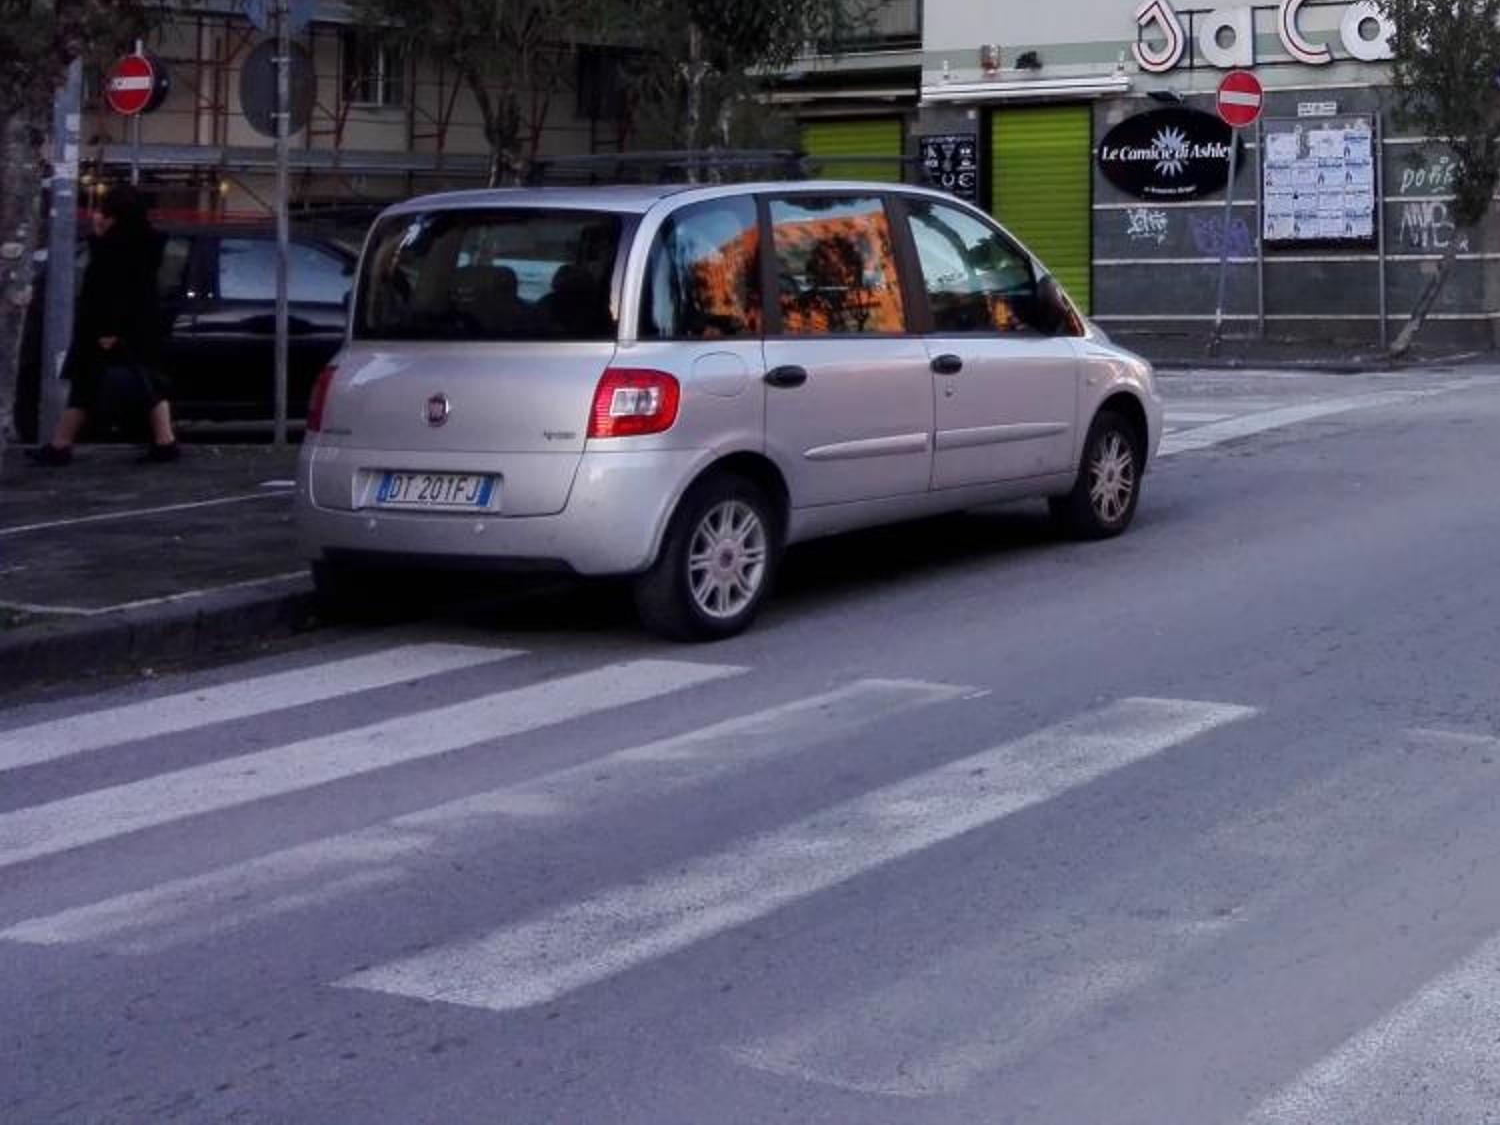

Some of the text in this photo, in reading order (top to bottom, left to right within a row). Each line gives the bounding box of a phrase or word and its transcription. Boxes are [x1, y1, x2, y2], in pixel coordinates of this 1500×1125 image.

[1102, 145, 1119, 161] Le
[1119, 145, 1174, 162] Camicie
[1190, 141, 1233, 162] Ashley
[390, 475, 480, 503] DT 201FJ
